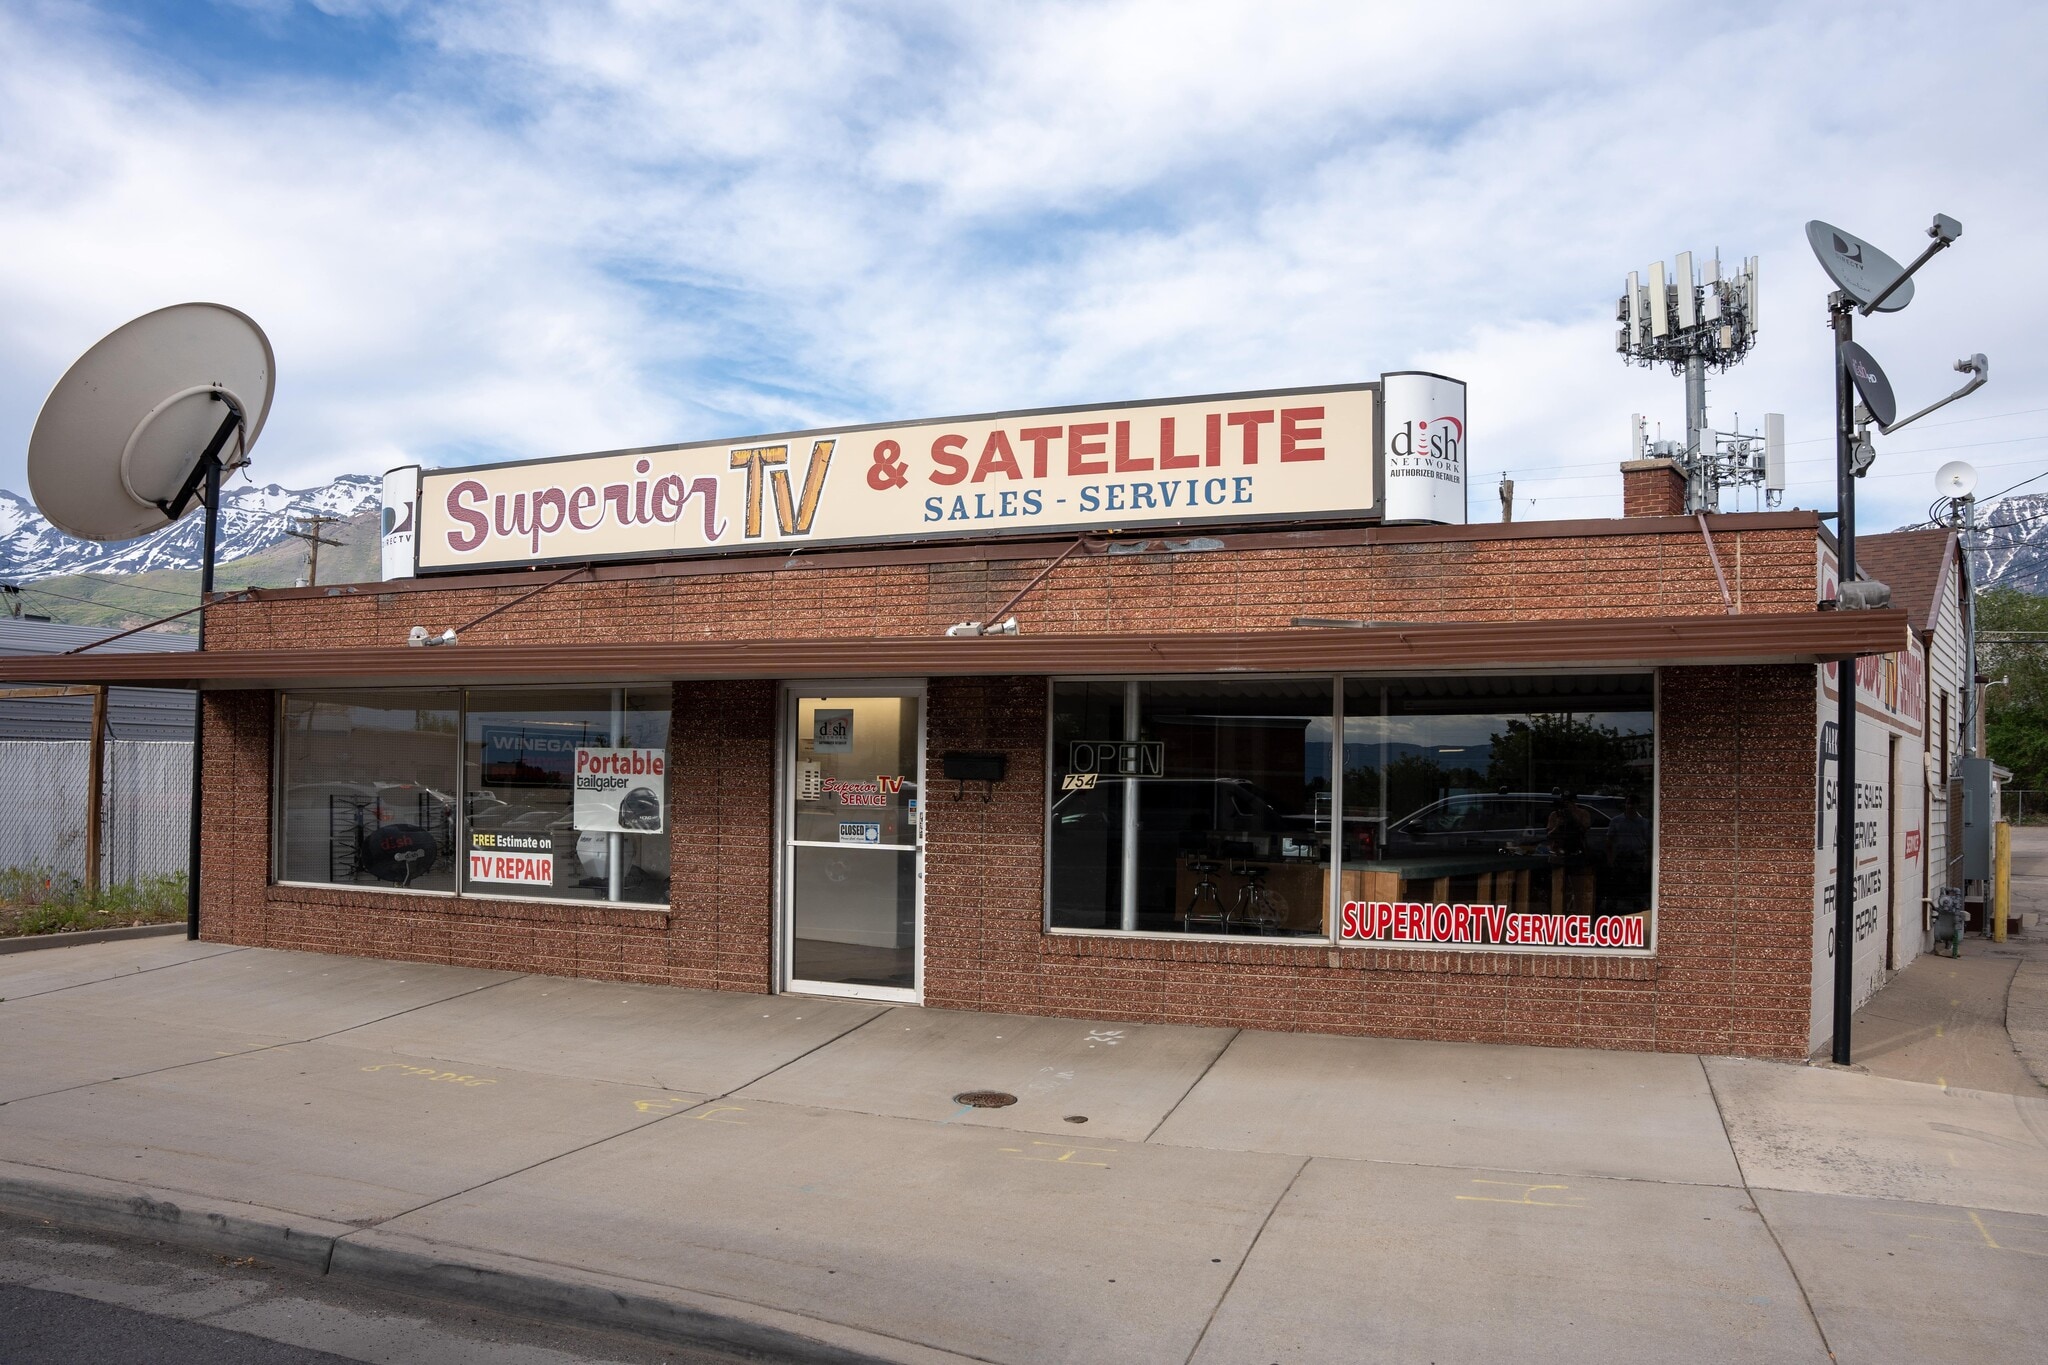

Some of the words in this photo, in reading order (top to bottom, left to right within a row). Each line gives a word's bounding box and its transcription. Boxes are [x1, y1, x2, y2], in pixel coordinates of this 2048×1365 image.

[1391, 416, 1462, 463] dish
[1390, 458, 1460, 473] NETWORK
[1390, 468, 1435, 478] AUTHORIZED
[1435, 471, 1460, 484] RETAILER
[446, 458, 728, 554] Superior
[730, 440, 837, 538] TV
[866, 440, 908, 491] &
[930, 406, 1326, 486] SATELLITE
[923, 489, 1043, 523] SALES
[1080, 476, 1254, 513] SERVICE
[577, 750, 664, 776] Portable
[1074, 744, 1160, 774] OPEN
[577, 774, 629, 792] tailgater
[823, 778, 878, 795] Superior
[877, 775, 904, 793] TV
[1065, 775, 1095, 788] 754
[840, 792, 887, 806] SERVICE
[1864, 783, 1883, 809] SALES
[473, 834, 496, 847] FREE
[497, 835, 538, 849] Estimate
[540, 838, 552, 849] on
[840, 824, 865, 836] CLOSED
[1854, 821, 1877, 850] ERVICE
[471, 856, 492, 878] TV
[495, 857, 552, 881] REPAIR
[1853, 868, 1881, 903] STIMATES
[1855, 905, 1877, 943] REPAIR
